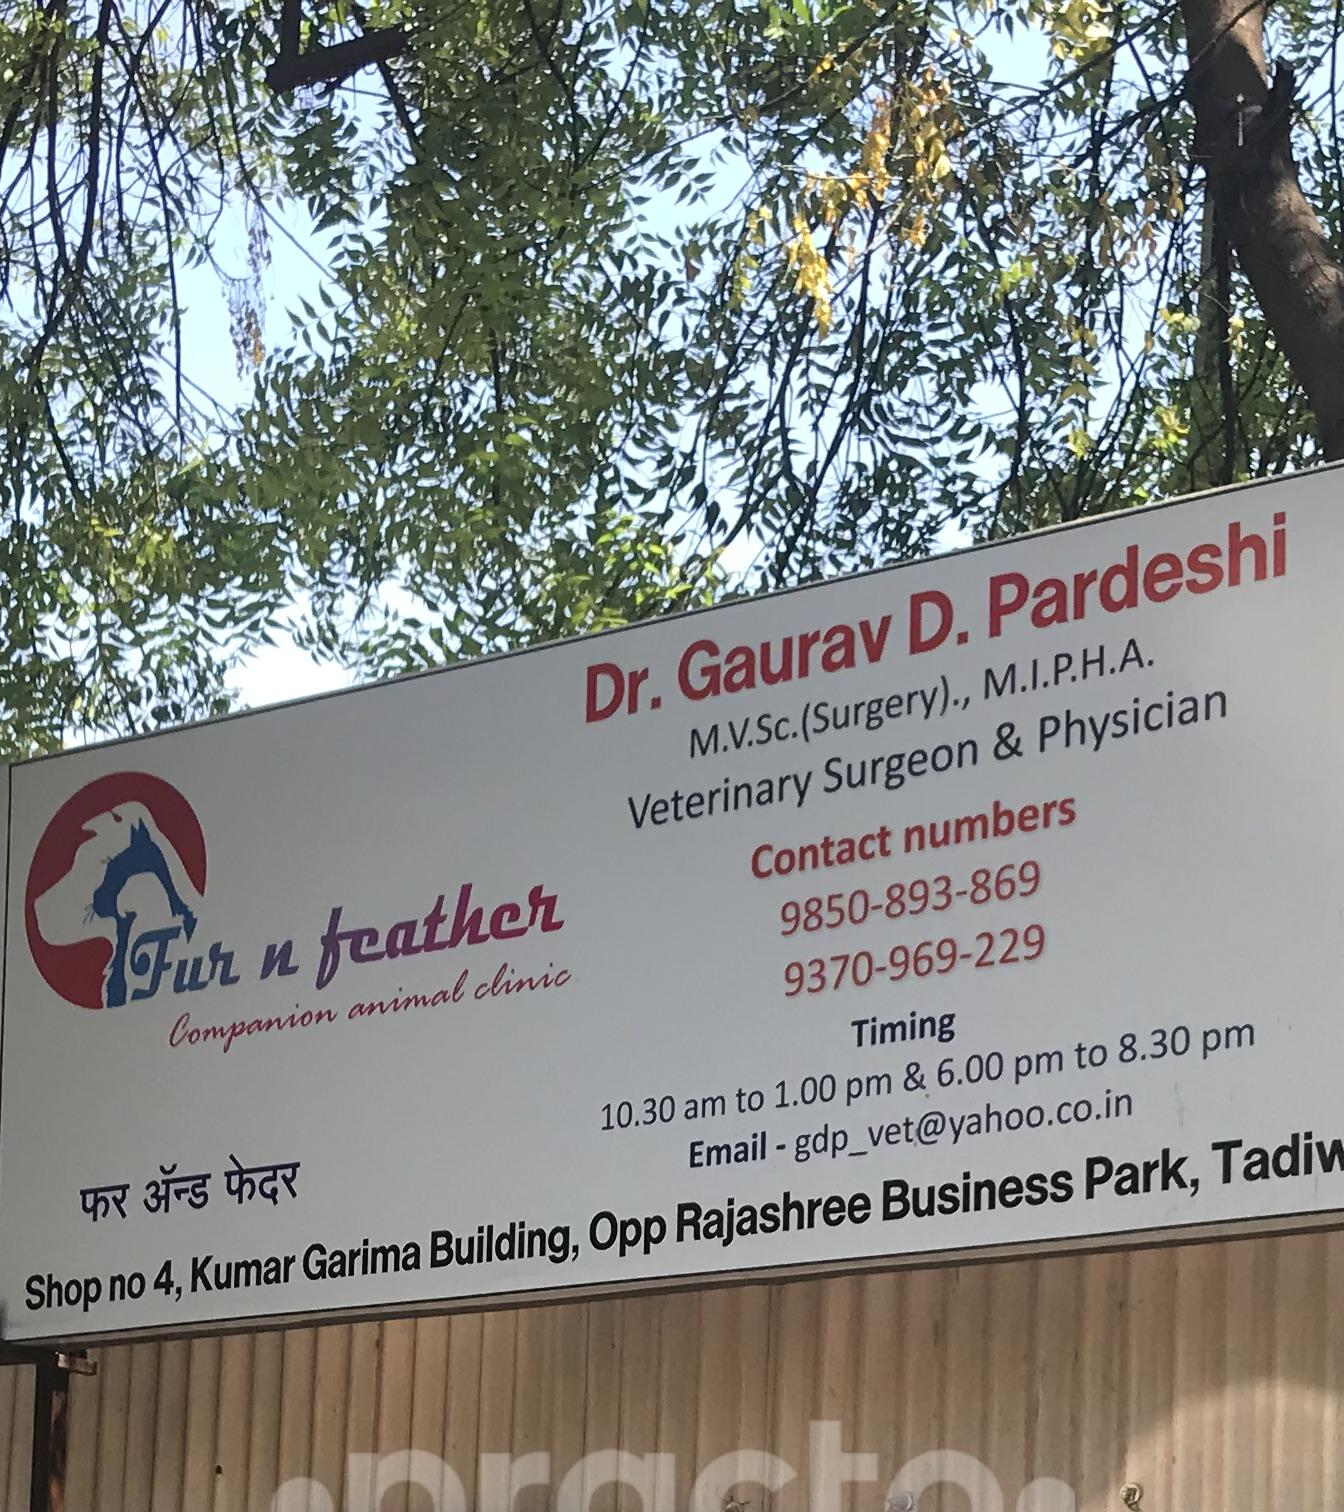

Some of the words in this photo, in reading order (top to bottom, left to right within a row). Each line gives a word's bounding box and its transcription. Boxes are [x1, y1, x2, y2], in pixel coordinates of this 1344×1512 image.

[585, 660, 663, 723] Dr.
[677, 612, 894, 701] Gaurav
[908, 589, 970, 656] D.
[988, 511, 1288, 637] Pardeshi
[983, 637, 1156, 698] M.I.P.H.A.
[628, 766, 814, 831] Veterinary
[822, 731, 980, 793] Surgeon
[993, 722, 1024, 760] &
[1038, 686, 1229, 755] Physician
[751, 825, 892, 879] Contact
[903, 797, 1077, 854] numbers
[779, 860, 1042, 937] 9850-893-869
[130, 922, 240, 1001] Fur
[260, 940, 299, 980] n
[316, 882, 564, 990] feather
[783, 922, 1047, 997] 9370-969-229
[168, 1001, 338, 1054] Companion
[348, 968, 467, 1018] animal
[474, 963, 573, 998] clinic
[851, 1011, 956, 1049] Timing
[599, 1096, 676, 1131] 10.30
[683, 1093, 727, 1120] am
[735, 1086, 765, 1114] to
[774, 1076, 836, 1109] 1.00
[845, 1071, 894, 1106] pm
[902, 1062, 927, 1092] &
[936, 1053, 1004, 1089] 6.00
[1014, 1047, 1064, 1082] pm
[1075, 1039, 1109, 1069] to
[1118, 1026, 1191, 1064] 8.30
[1202, 1020, 1256, 1055] pm
[689, 1134, 768, 1168] Email
[794, 1089, 1133, 1163] gdp_vet@yahoo.co.in
[80, 1183, 130, 1222] फर
[224, 1153, 301, 1206] फेदर
[24, 1275, 102, 1312] Shop
[109, 1272, 145, 1300] no
[154, 1260, 182, 1302] 4,
[190, 1250, 296, 1293] Kumar
[302, 1237, 422, 1283] Garima
[430, 1217, 581, 1265] Building,
[588, 1212, 667, 1259] Opp
[675, 1183, 872, 1249] Rajashree
[882, 1162, 1074, 1219] Business
[1085, 1147, 1200, 1199] Park,
